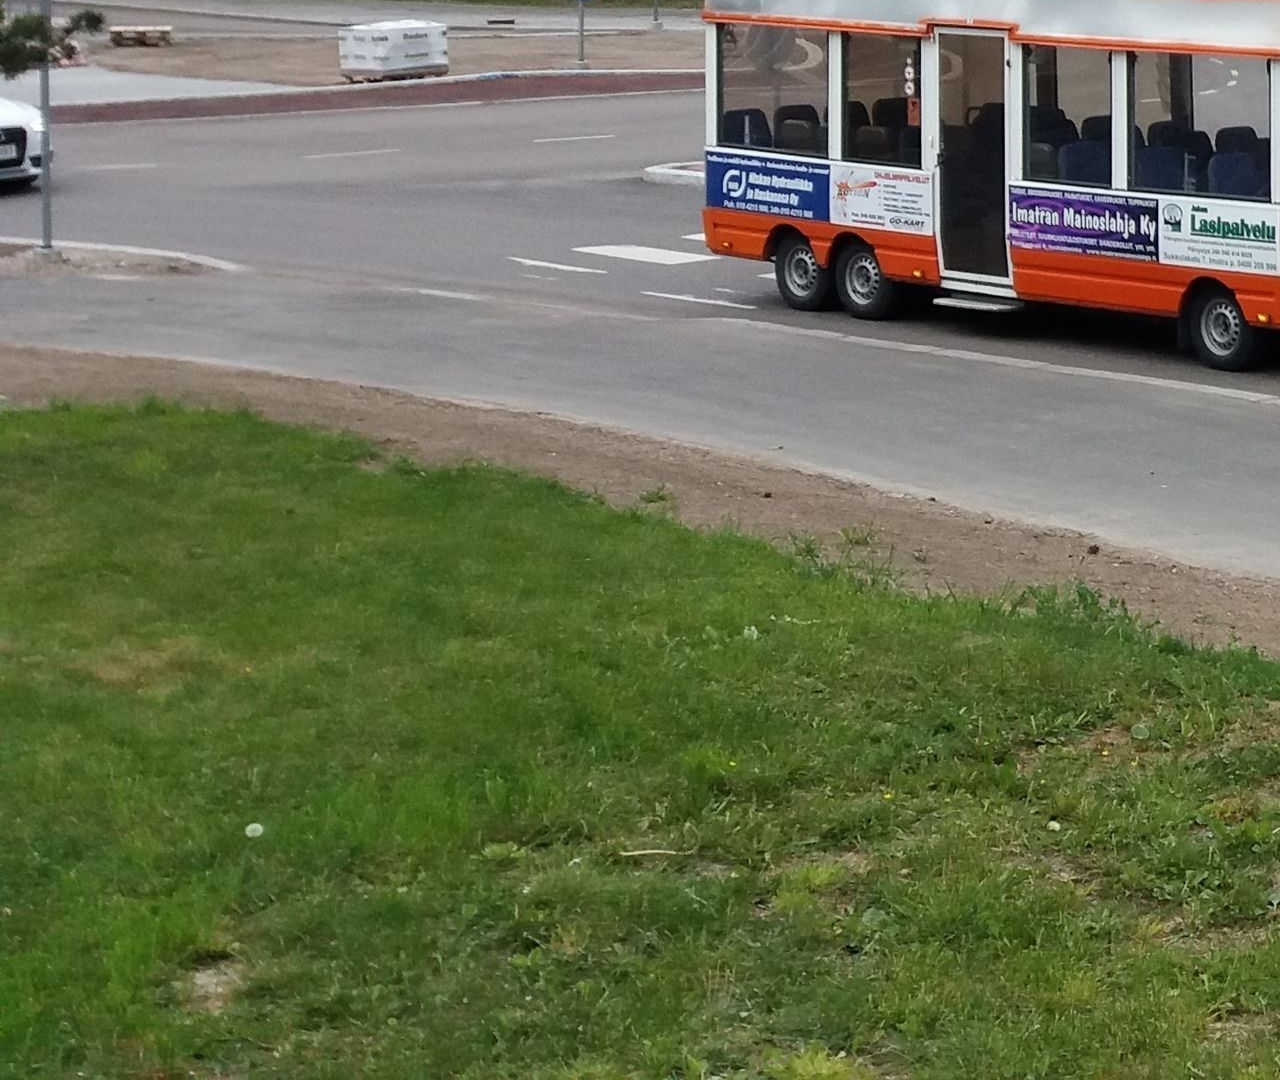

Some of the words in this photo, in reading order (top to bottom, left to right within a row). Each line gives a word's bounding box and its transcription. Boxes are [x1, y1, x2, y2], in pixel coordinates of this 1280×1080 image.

[1012, 201, 1059, 225] Imatran
[1063, 206, 1136, 239] Mainoslahja
[1140, 214, 1156, 242] Ky
[1190, 213, 1276, 240] Lasipalvelu
